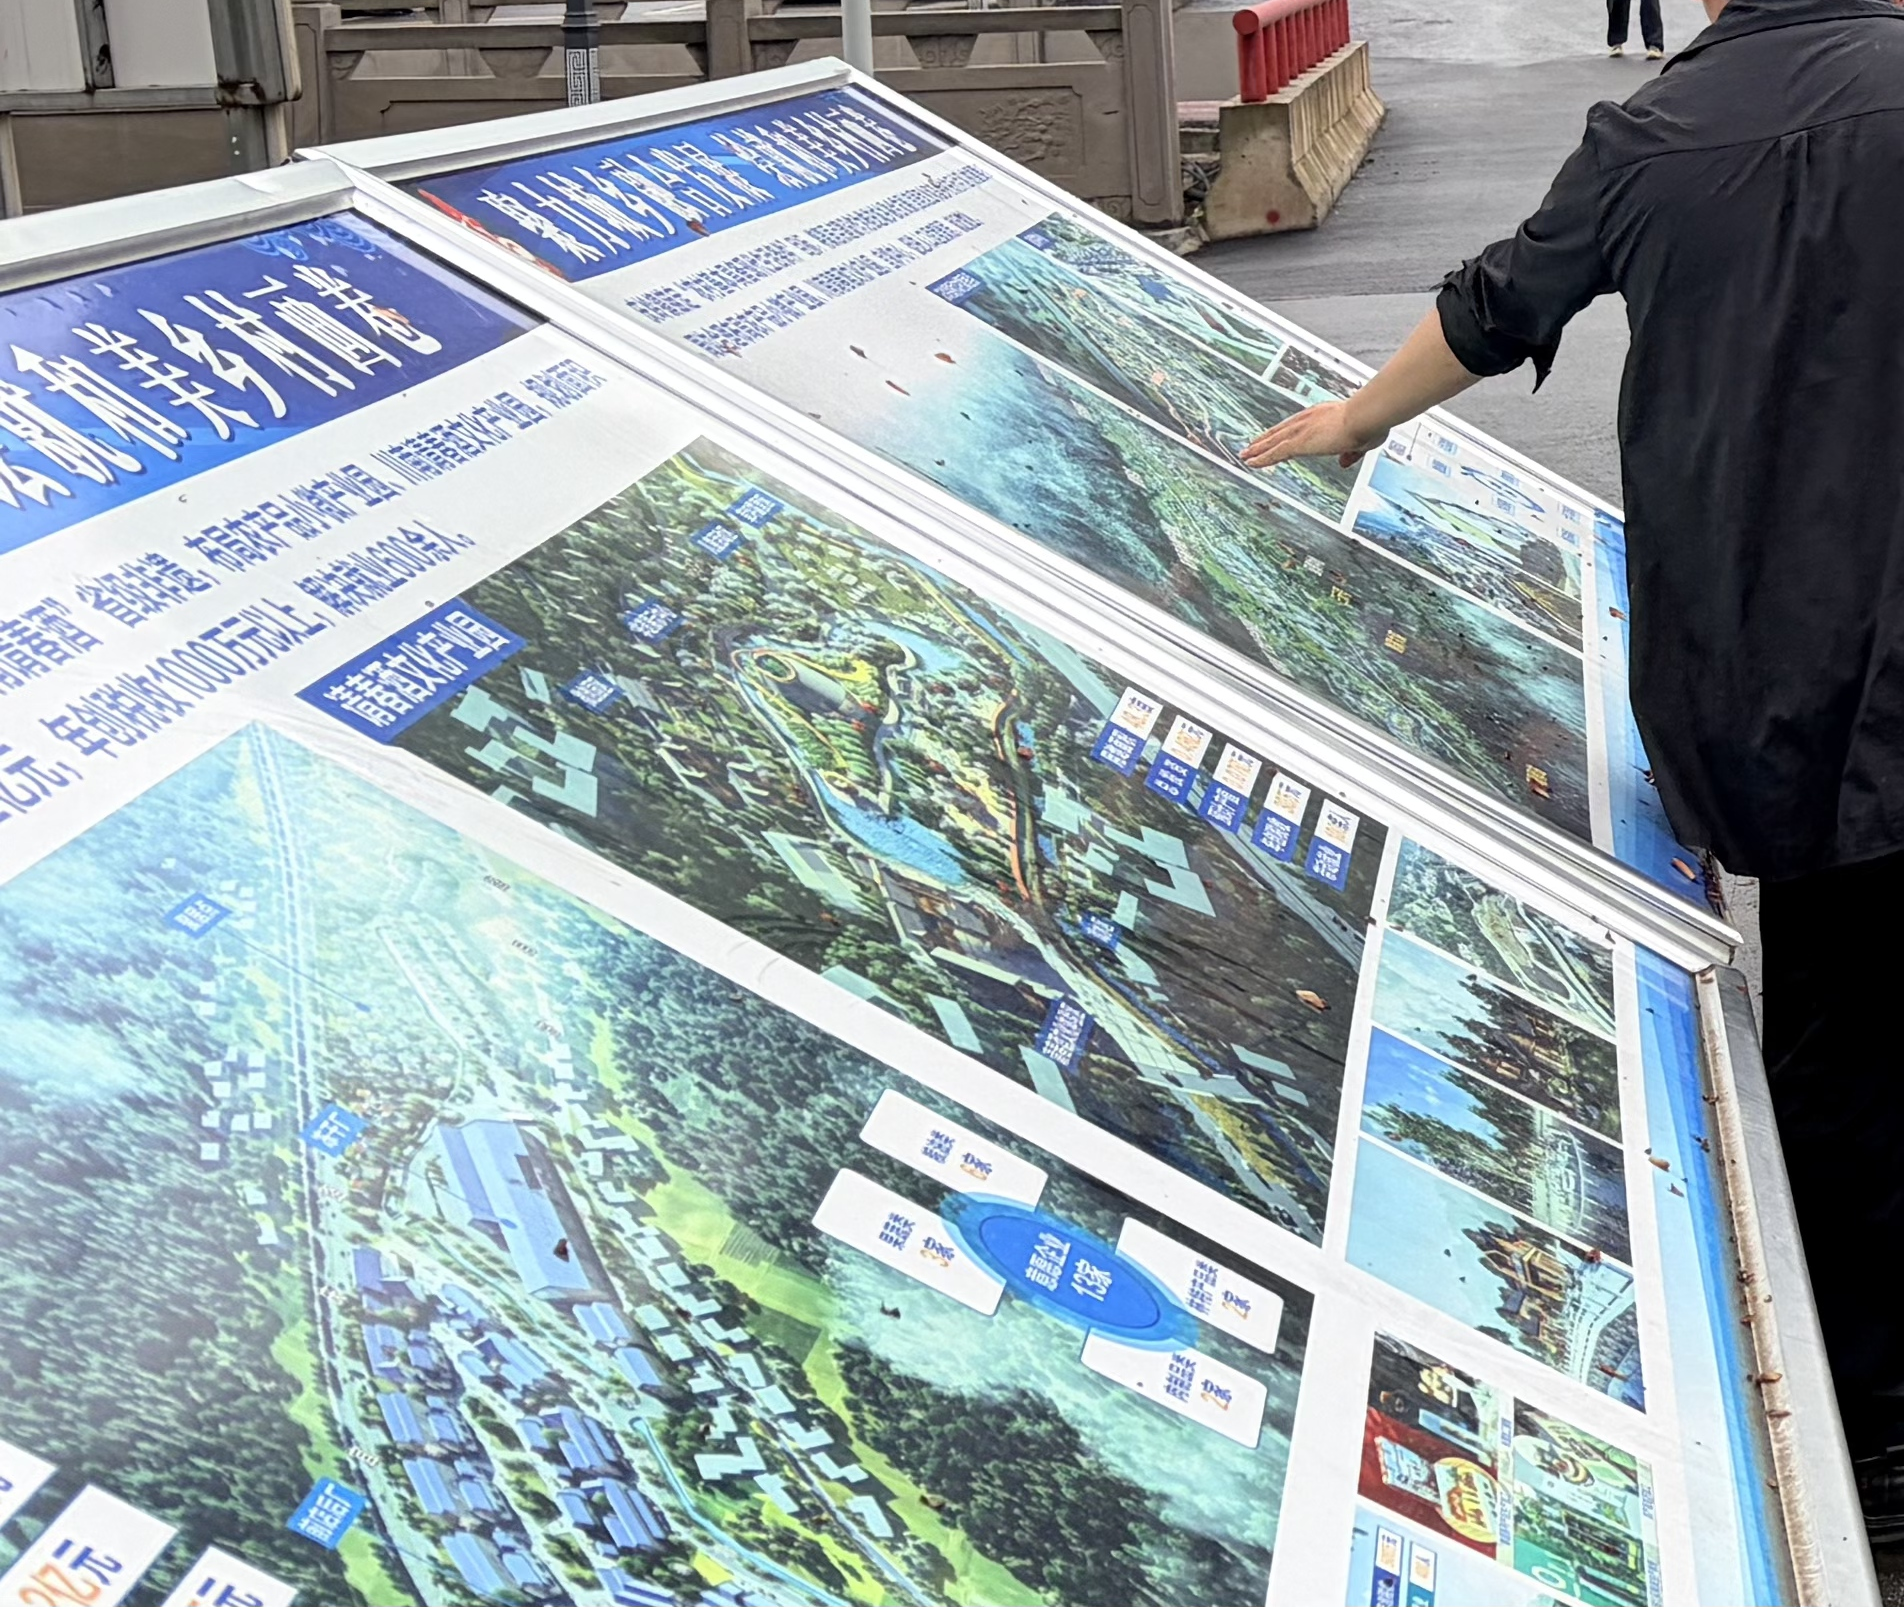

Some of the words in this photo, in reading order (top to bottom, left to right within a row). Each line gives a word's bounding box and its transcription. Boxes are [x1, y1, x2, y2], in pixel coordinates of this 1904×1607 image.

[477, 139, 768, 263] 聚力城乡融合发展
[711, 104, 918, 191] 绘就和美乡村画卷
[0, 520, 476, 820] 亿元，年创税收1000万元以上，解决就业600余人。
[322, 608, 518, 729] 请春酒文化产业园
[921, 1129, 956, 1165] 粮油类
[960, 1151, 993, 1181] 6家
[879, 1211, 917, 1251] 果蔬类
[919, 1235, 955, 1268] 3家
[1025, 1231, 1071, 1292] 意愿企业
[1070, 1258, 1114, 1302] 13家
[1186, 1258, 1219, 1316] 林特产品类
[1222, 1287, 1252, 1321] 2家
[1201, 1378, 1233, 1411] 2家
[298, 1483, 350, 1540] 前店后厂
